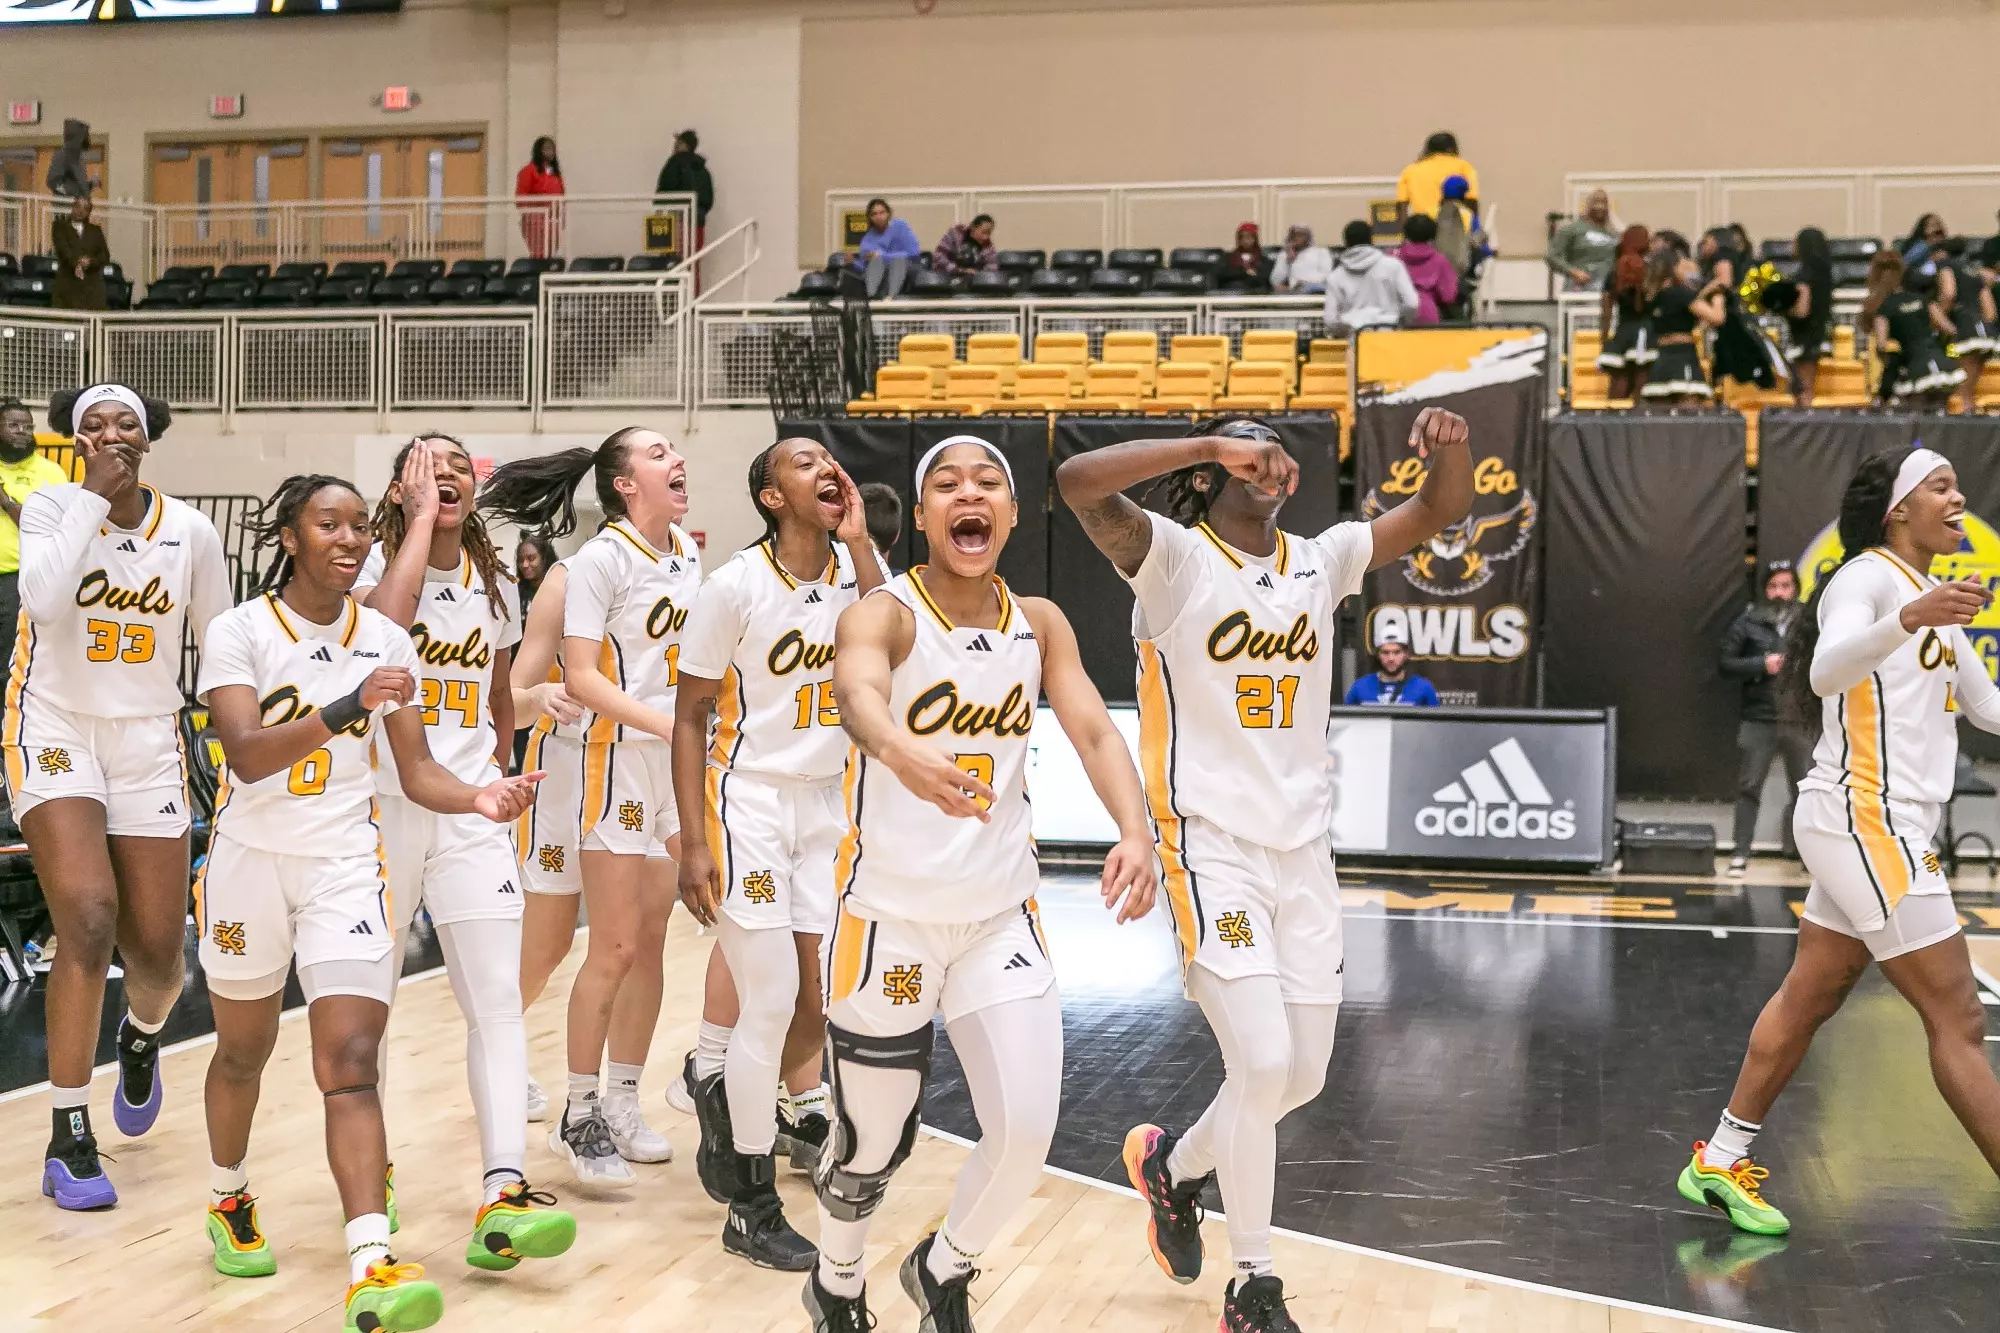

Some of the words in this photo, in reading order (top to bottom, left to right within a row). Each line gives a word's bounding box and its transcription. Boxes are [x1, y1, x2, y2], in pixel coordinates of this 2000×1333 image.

[1474, 456, 1518, 495] Go
[75, 568, 175, 616] Owls
[86, 618, 155, 663] 33
[767, 628, 837, 677] Ow
[1206, 608, 1319, 664] Owls
[421, 678, 480, 728] 24
[904, 679, 1032, 739] Owls
[1235, 675, 1300, 729] 21
[287, 748, 332, 796] 0
[1414, 799, 1577, 841] adidas
